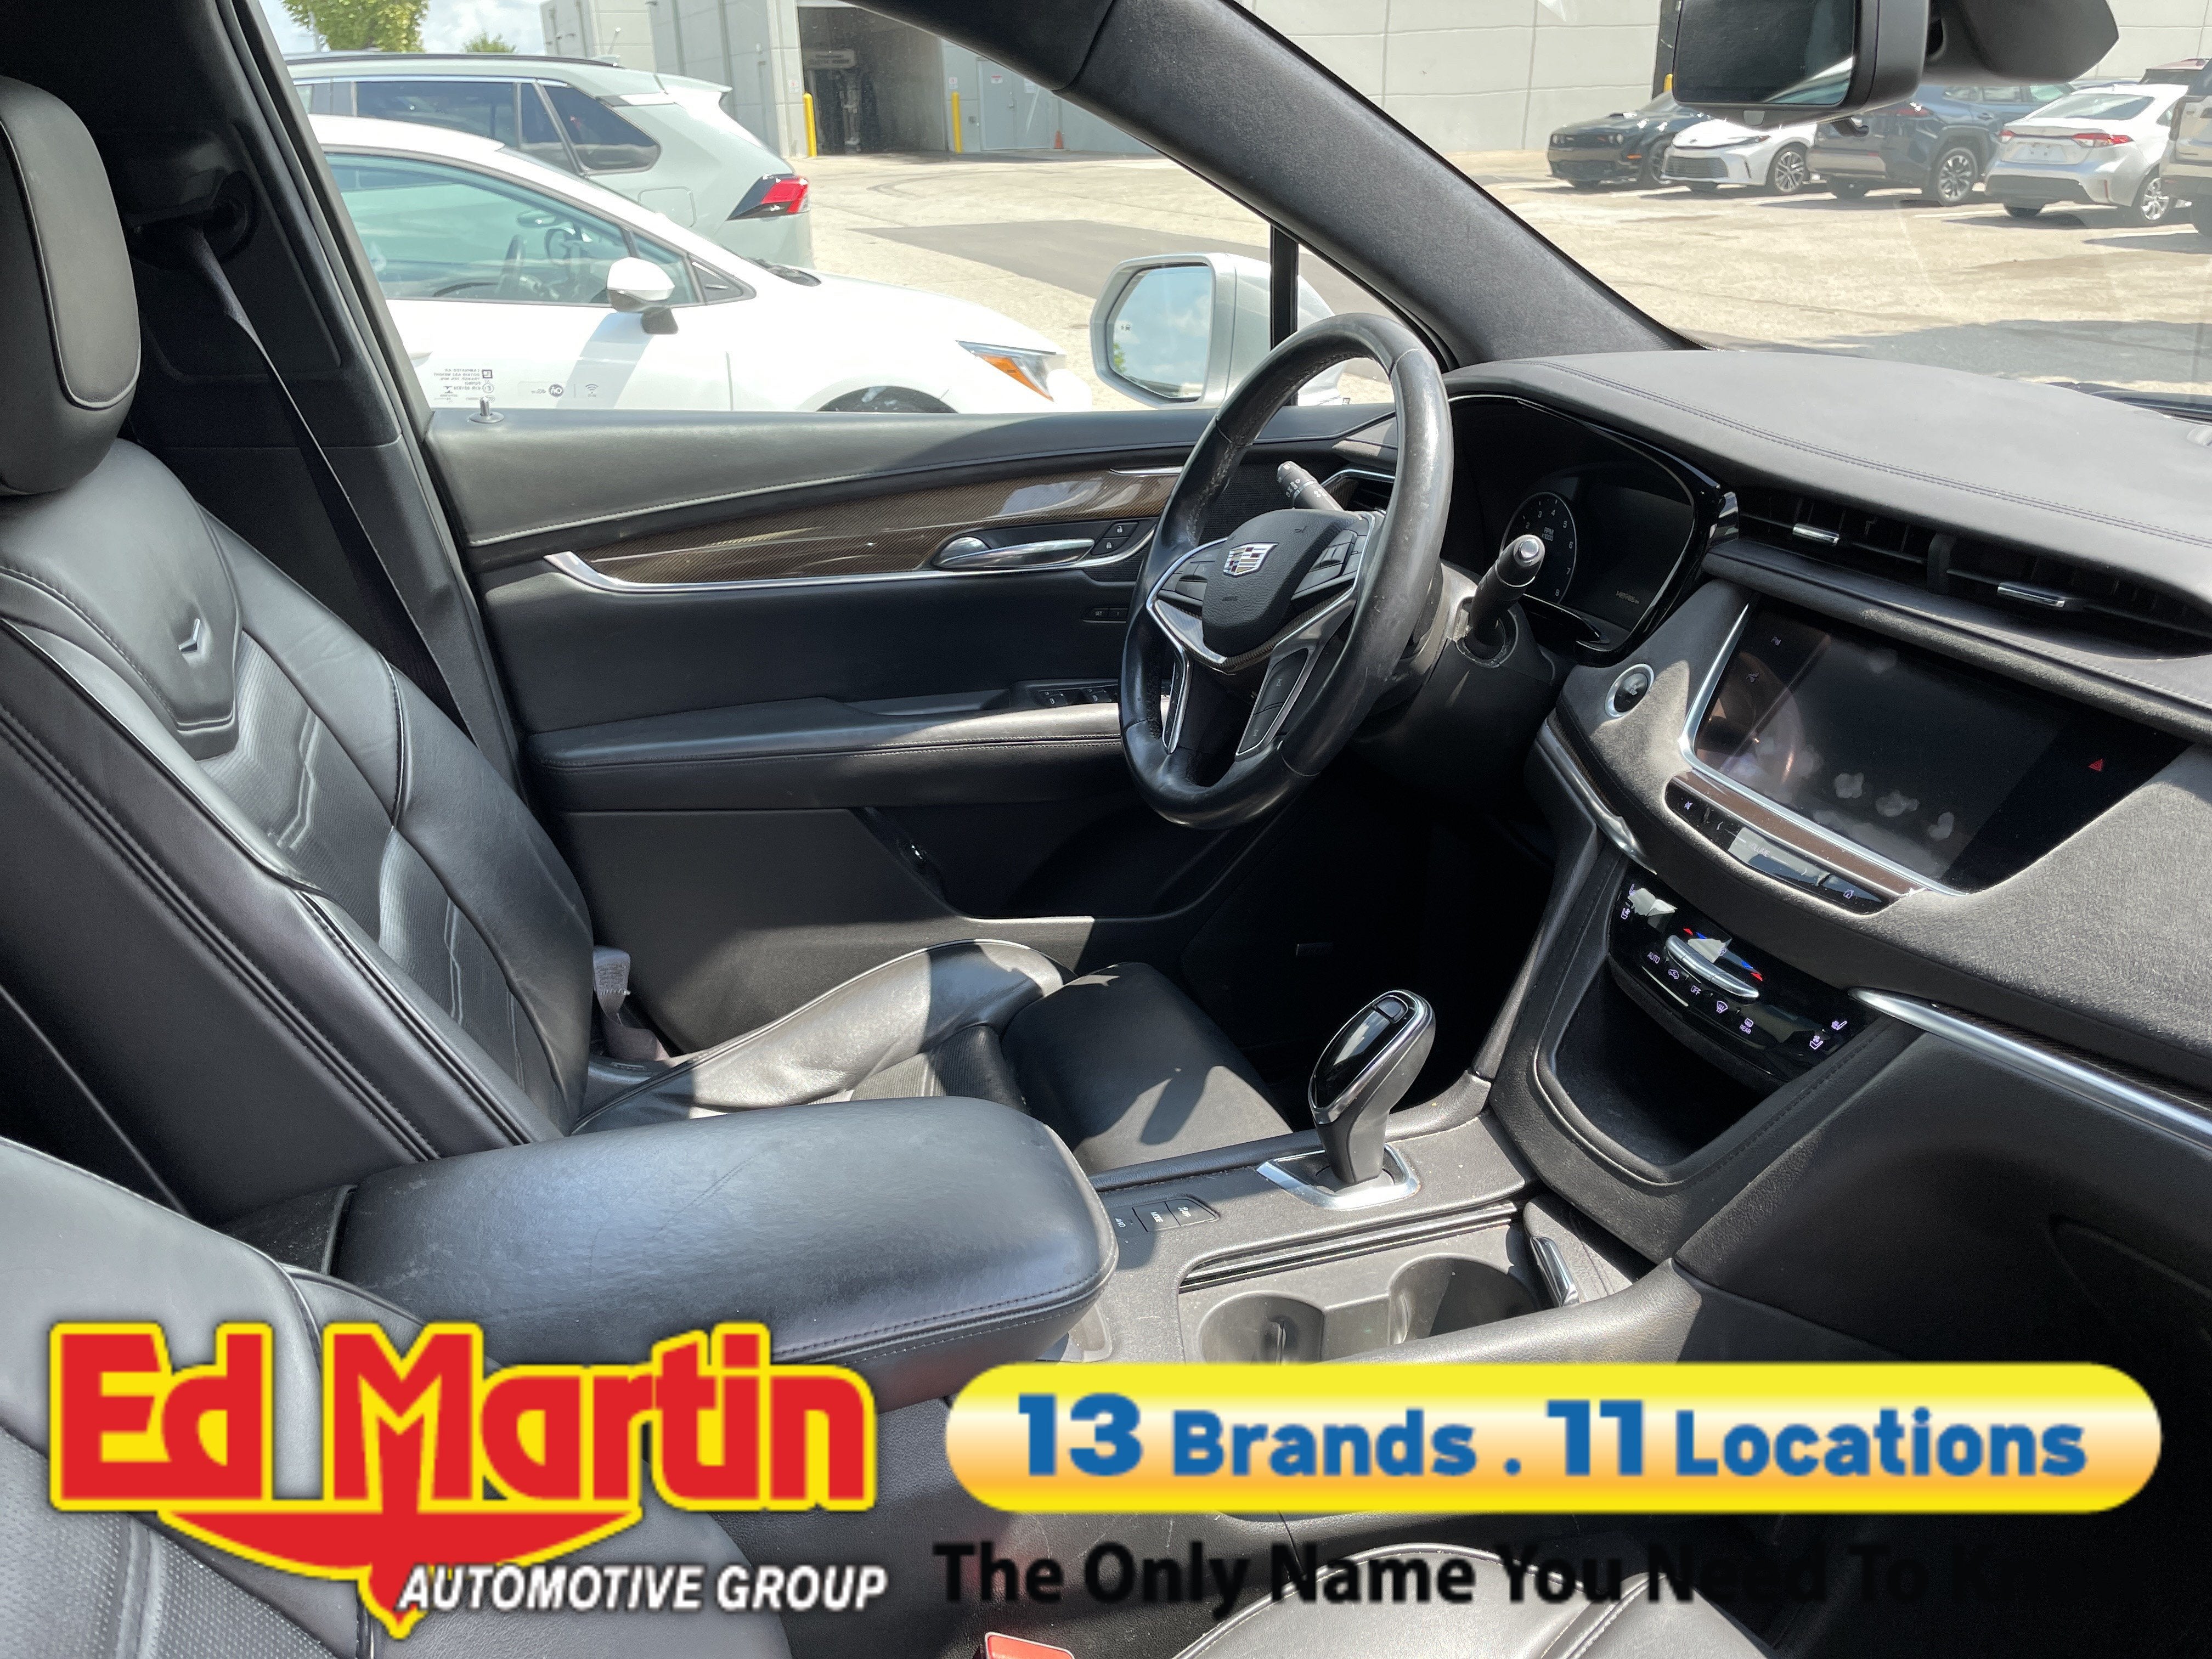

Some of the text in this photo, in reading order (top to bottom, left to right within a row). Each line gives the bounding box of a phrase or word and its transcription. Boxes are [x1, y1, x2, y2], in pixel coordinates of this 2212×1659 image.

[1748, 842, 1770, 857] VOLUME
[1647, 952, 1660, 964] AUTO
[1690, 985, 1701, 995] OFF
[1739, 1024, 1752, 1034] REAR
